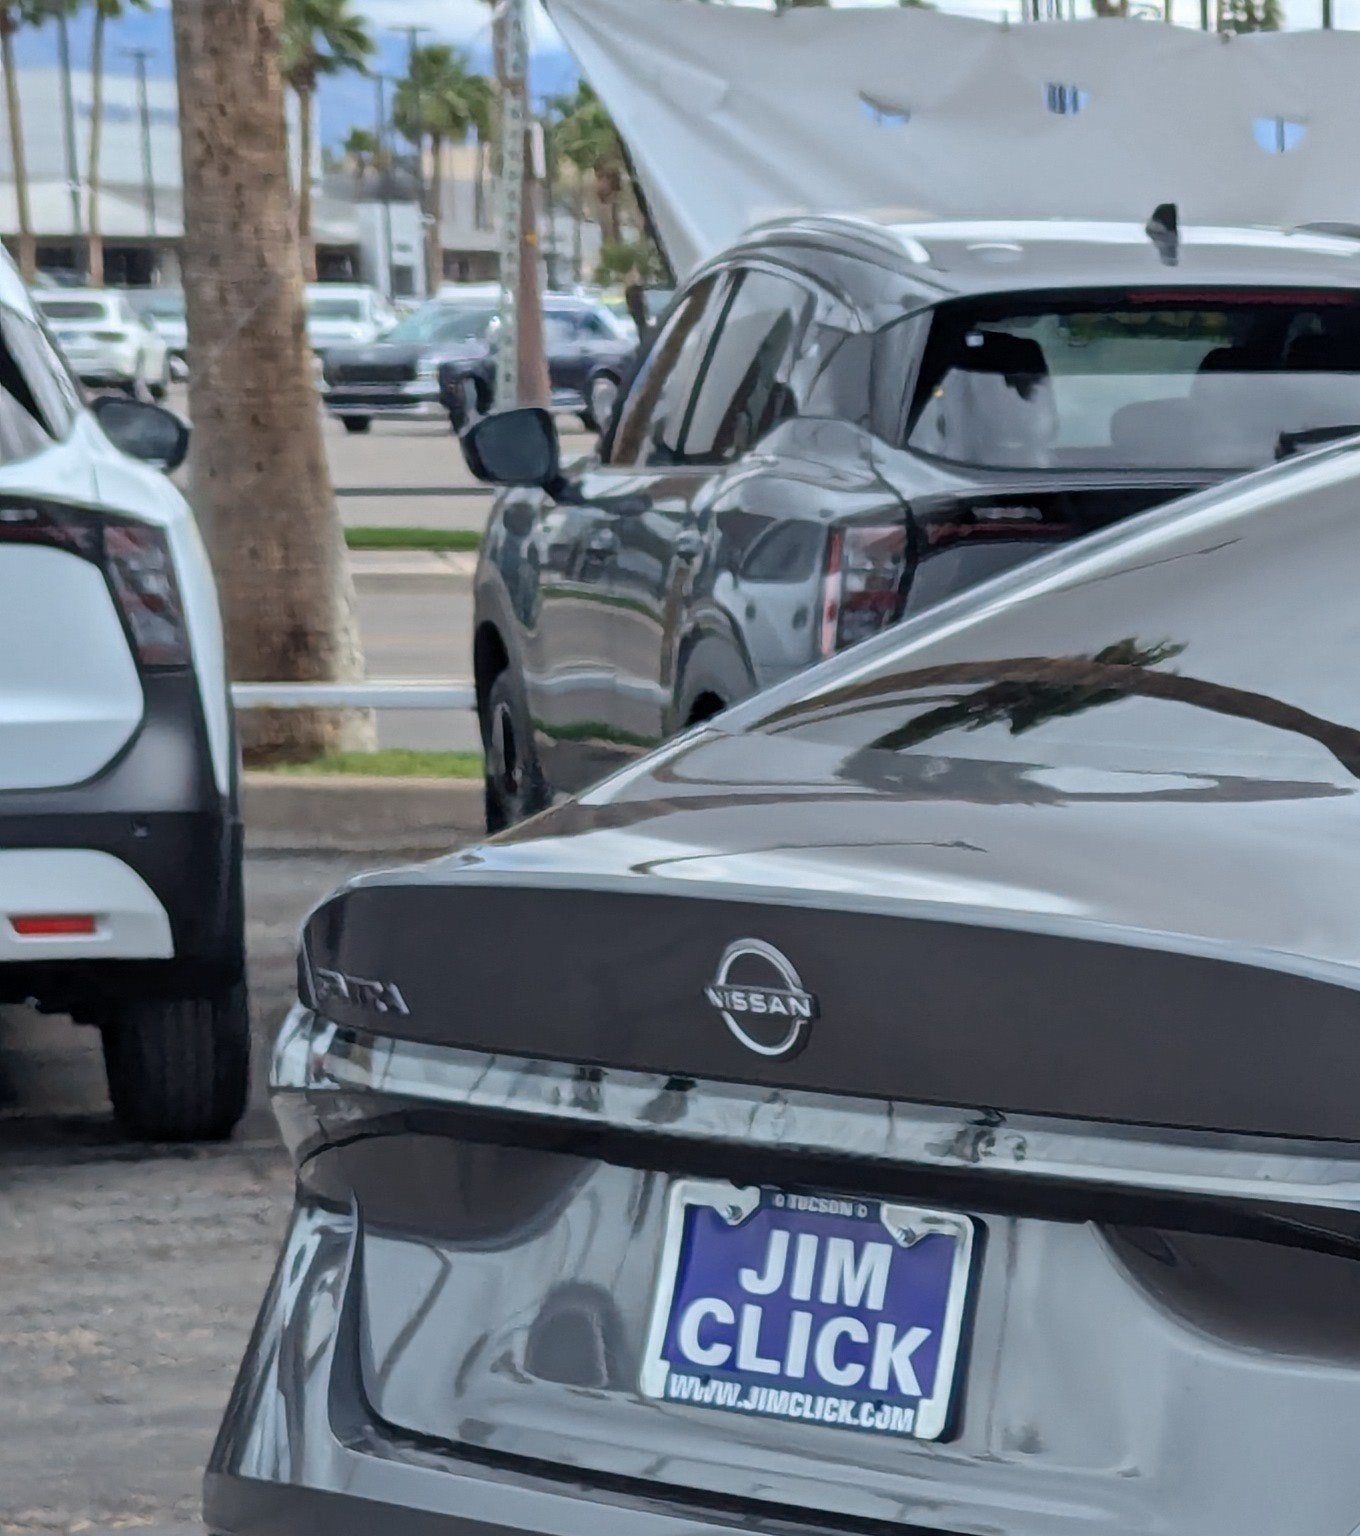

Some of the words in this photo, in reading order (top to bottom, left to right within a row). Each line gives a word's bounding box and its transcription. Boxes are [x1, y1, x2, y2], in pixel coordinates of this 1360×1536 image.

[704, 987, 812, 1018] NISSAN
[738, 1228, 893, 1311] JIM
[678, 1297, 932, 1397] CLICK
[668, 1373, 915, 1432] WWW.JIMCLICK.COM
